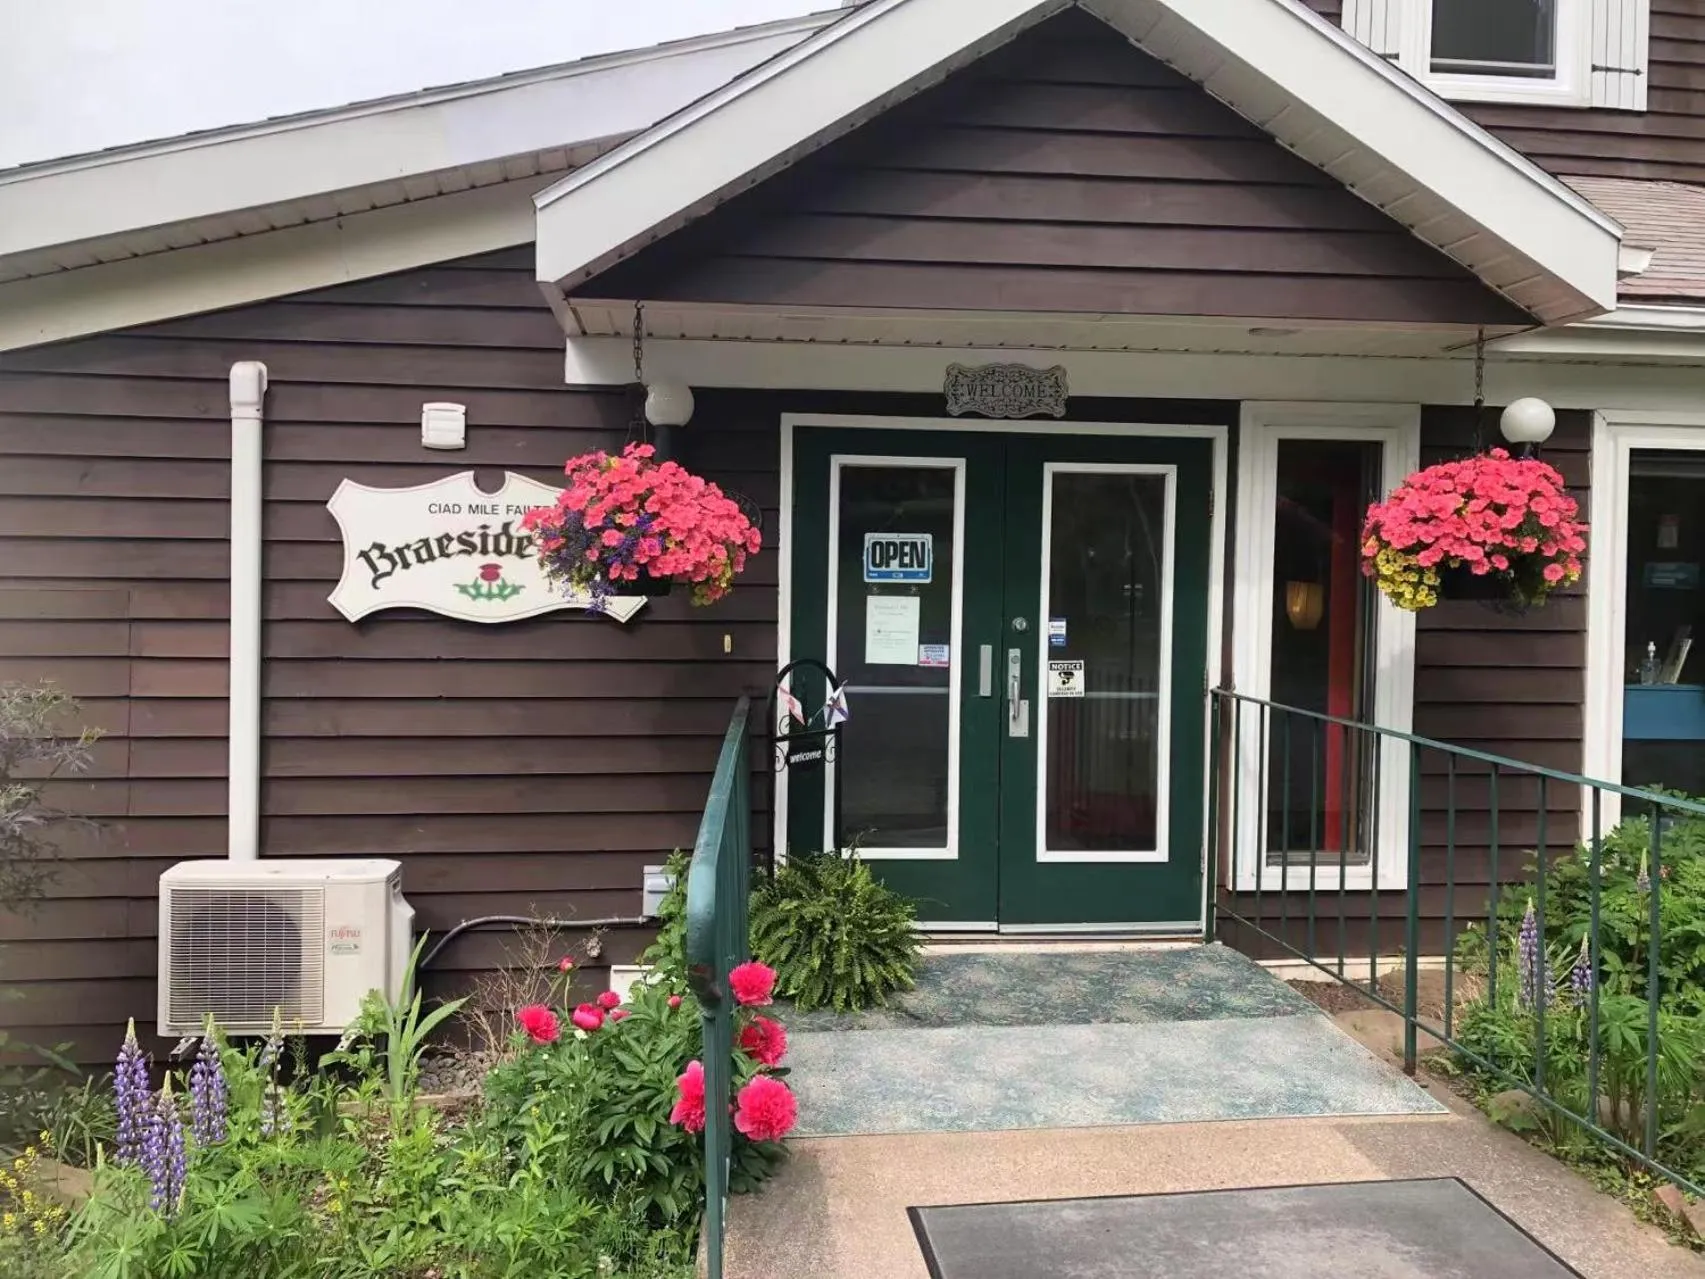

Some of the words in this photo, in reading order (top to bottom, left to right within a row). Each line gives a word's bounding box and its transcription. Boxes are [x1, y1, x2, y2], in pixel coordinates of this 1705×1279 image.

[966, 383, 1048, 398] WELCOME
[428, 503, 462, 515] CIAD
[468, 504, 499, 515] MILE
[356, 520, 535, 590] Braeside
[871, 541, 926, 569] OPEN
[790, 750, 822, 763] welcome
